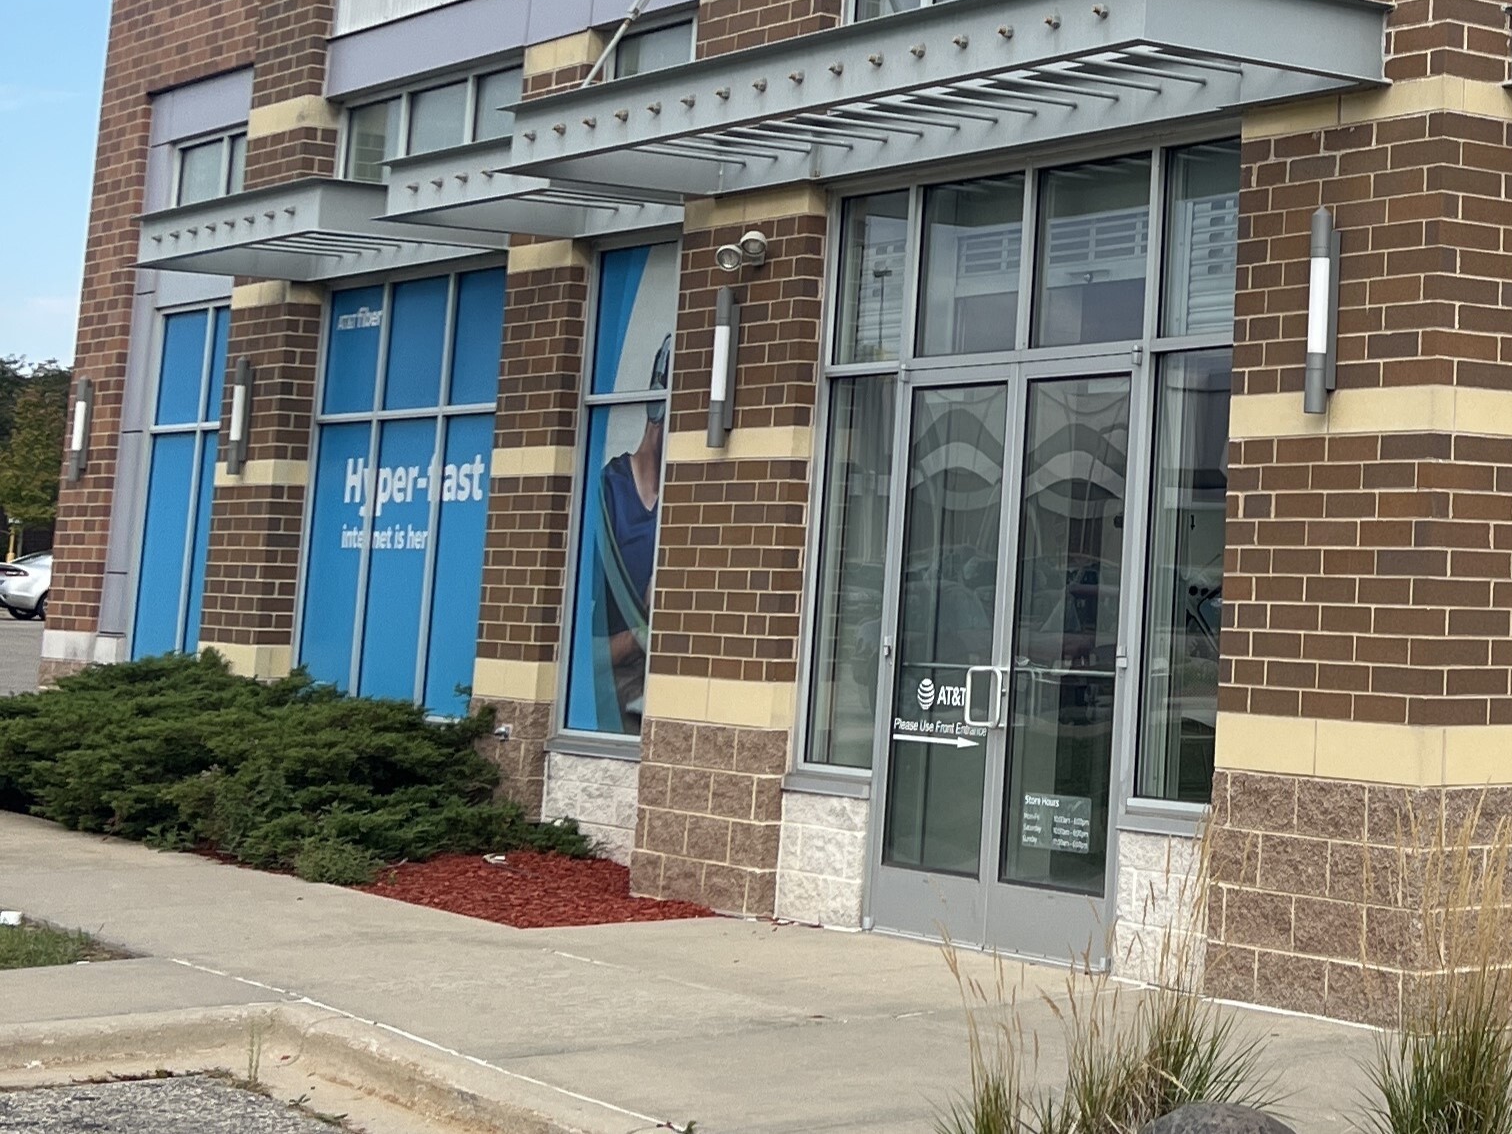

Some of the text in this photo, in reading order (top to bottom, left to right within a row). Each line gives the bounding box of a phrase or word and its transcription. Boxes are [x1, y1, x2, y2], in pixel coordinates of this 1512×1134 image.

[341, 523, 429, 550] intenet is her
[937, 685, 967, 707] AT&T
[893, 717, 987, 737] Please Use Front Entrance
[1024, 794, 1060, 808] Store Hours
